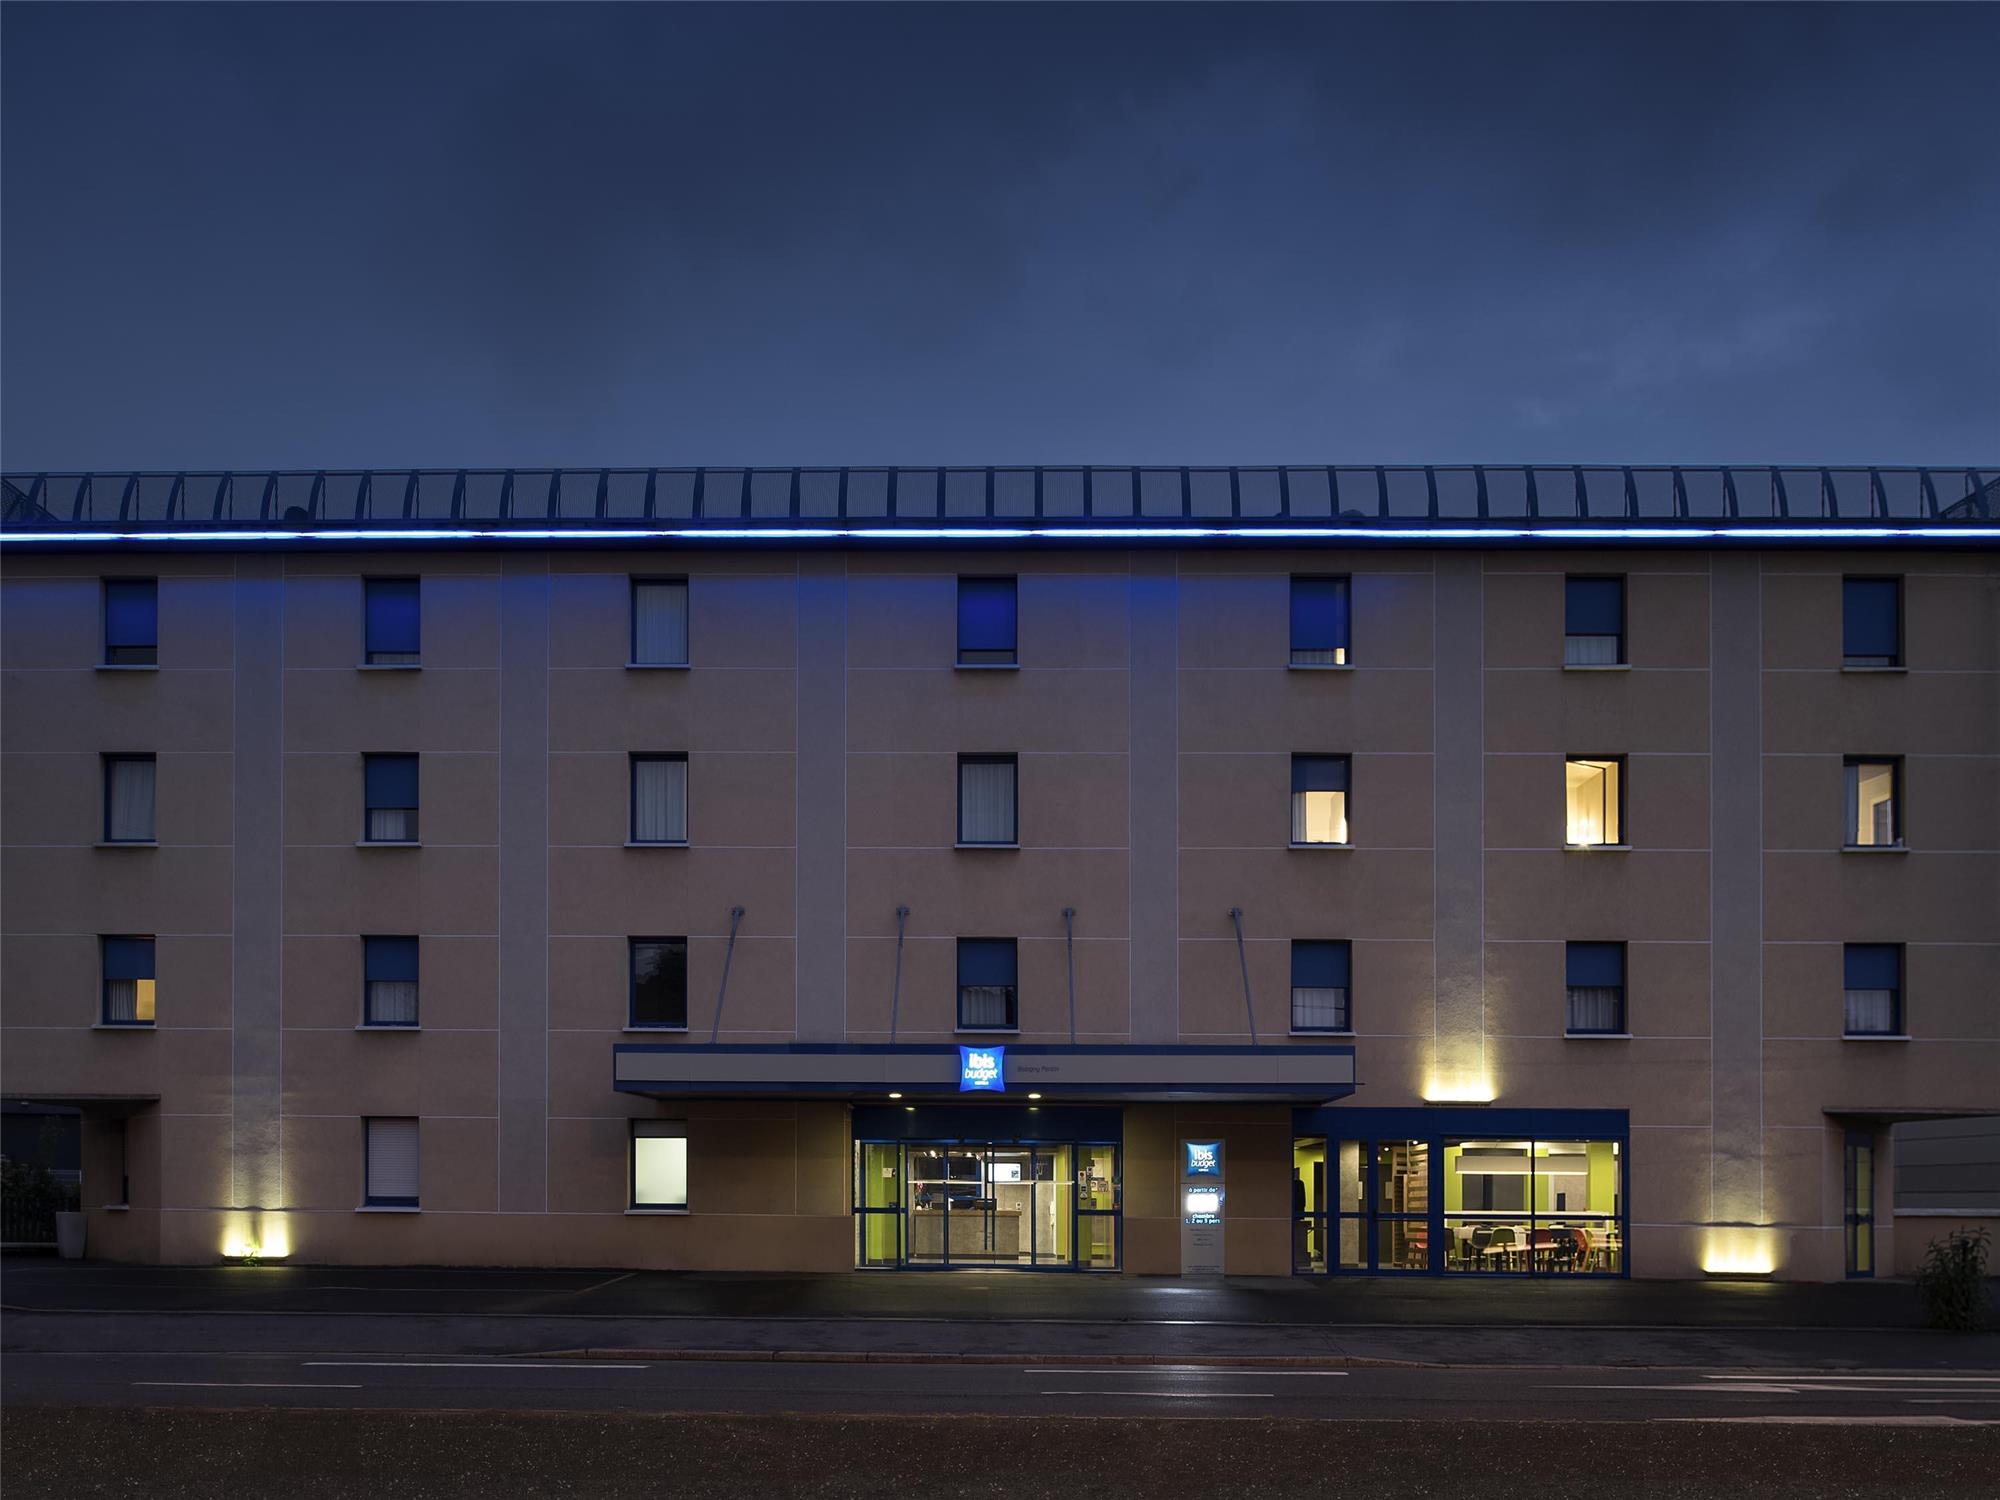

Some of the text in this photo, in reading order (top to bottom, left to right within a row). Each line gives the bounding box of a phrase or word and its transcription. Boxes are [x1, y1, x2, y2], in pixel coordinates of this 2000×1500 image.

[969, 1053, 995, 1068] ibis
[965, 1068, 998, 1080] budget
[1194, 1148, 1213, 1160] ibis
[1191, 1159, 1216, 1168] budget
